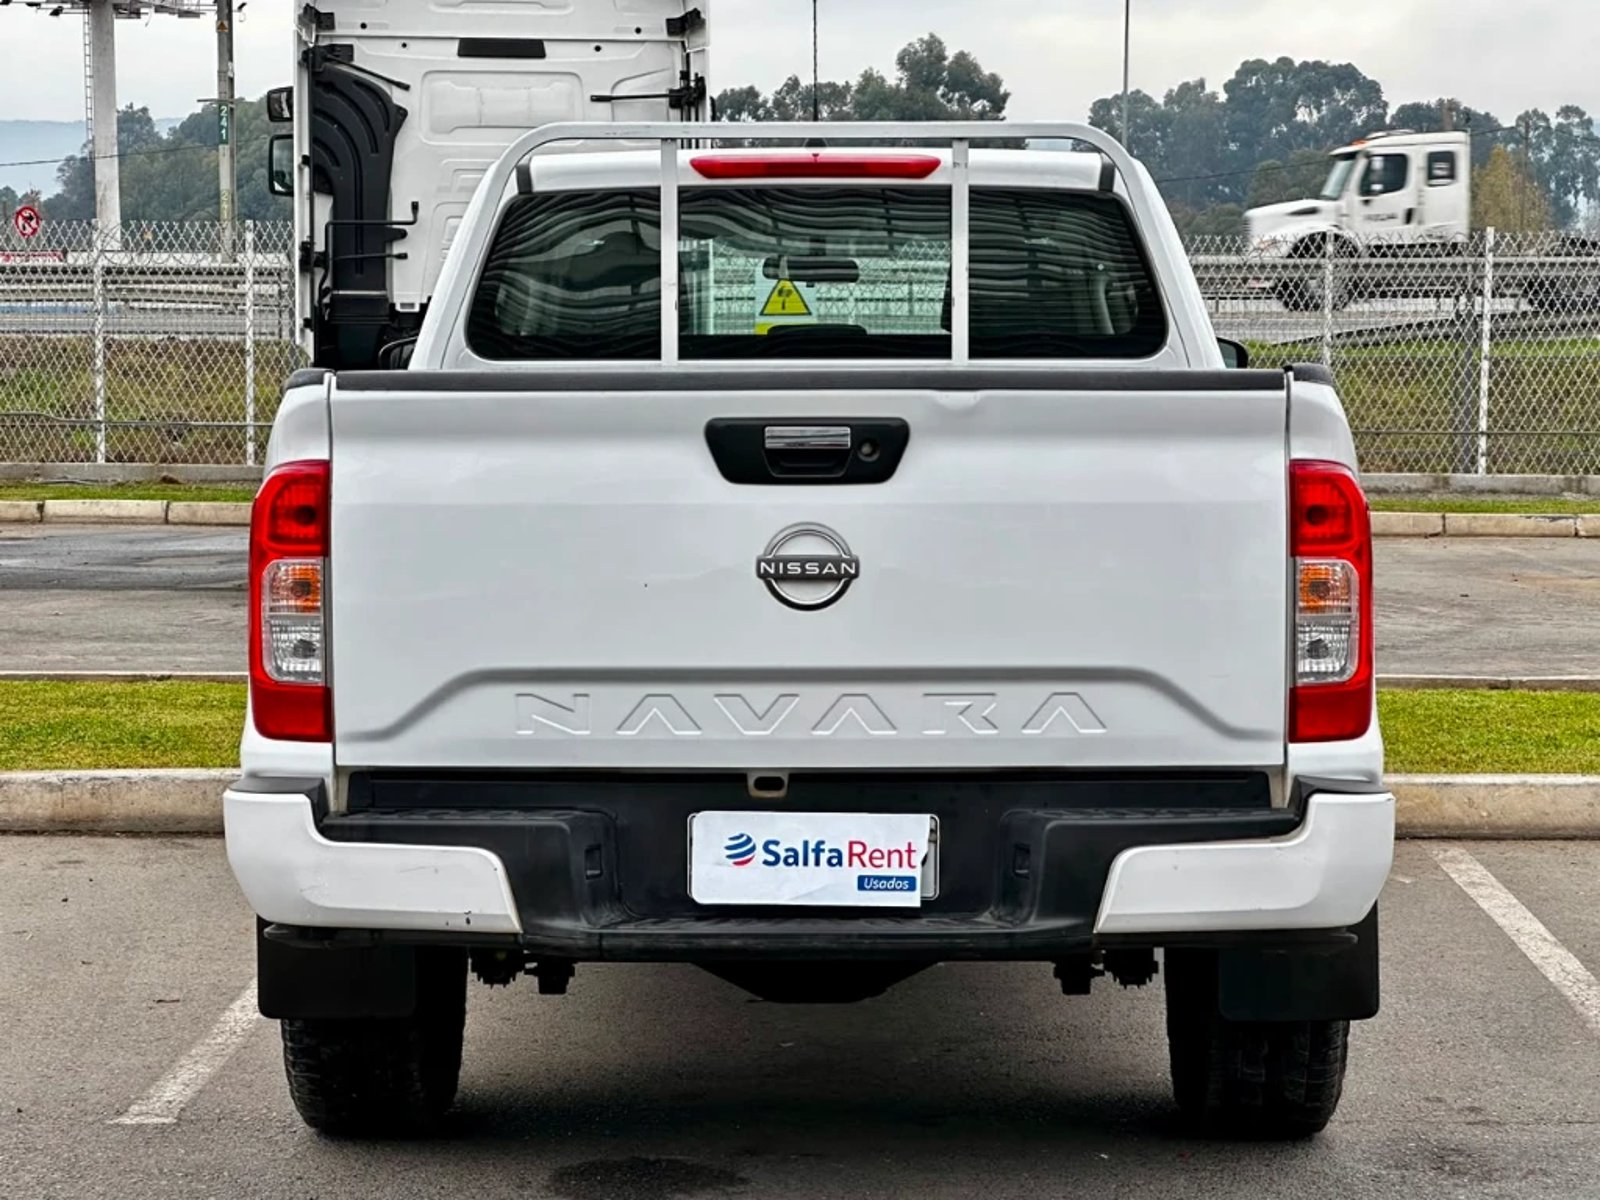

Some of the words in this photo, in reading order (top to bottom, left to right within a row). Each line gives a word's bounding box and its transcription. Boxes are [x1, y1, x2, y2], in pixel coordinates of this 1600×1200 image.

[220, 105, 228, 140] 241
[760, 561, 856, 575] NISSAN
[514, 691, 1108, 735] NAVARA
[863, 877, 909, 890] Usados
